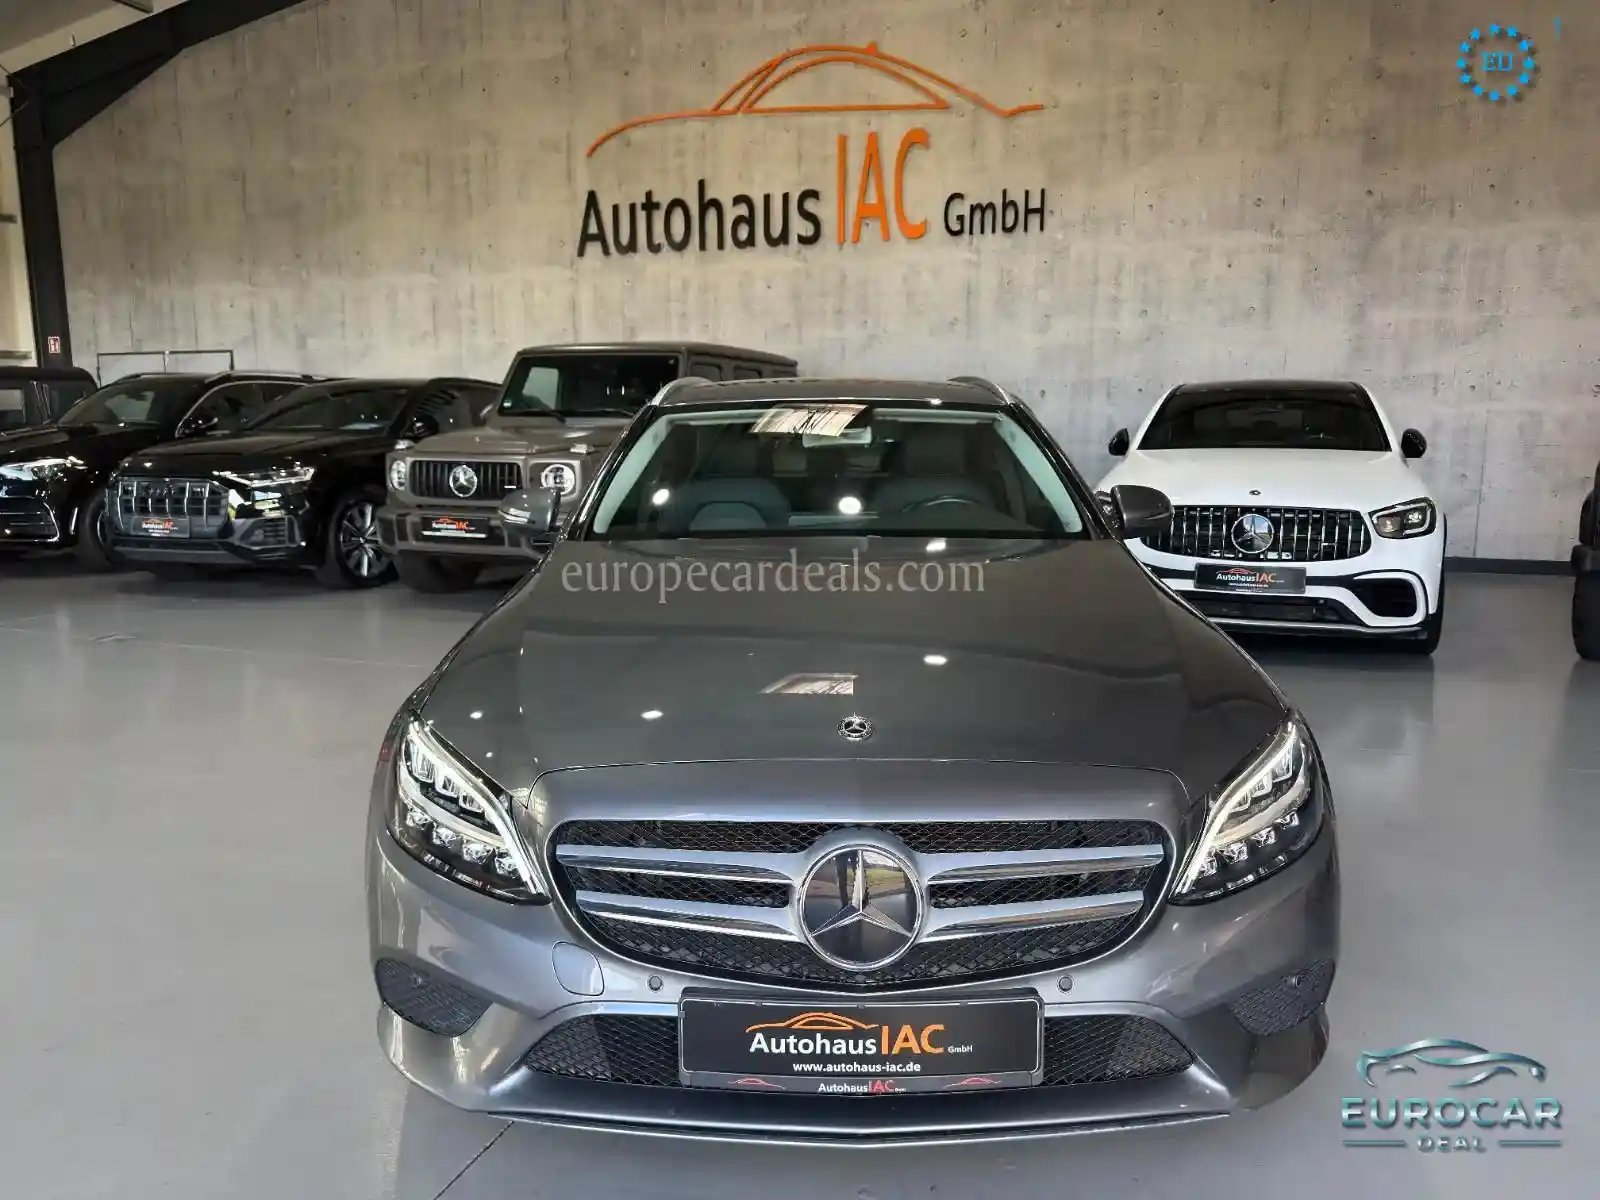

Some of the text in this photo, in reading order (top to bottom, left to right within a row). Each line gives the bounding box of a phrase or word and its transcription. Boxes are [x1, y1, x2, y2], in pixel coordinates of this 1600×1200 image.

[577, 127, 1047, 258] Autohaus IAC GmbH
[749, 1024, 974, 1056] Autohaus IAC GmbH
[792, 1061, 922, 1073] www.autohaus-iac.de
[818, 1082, 868, 1093] Autohaus
[868, 1079, 895, 1093] IAC
